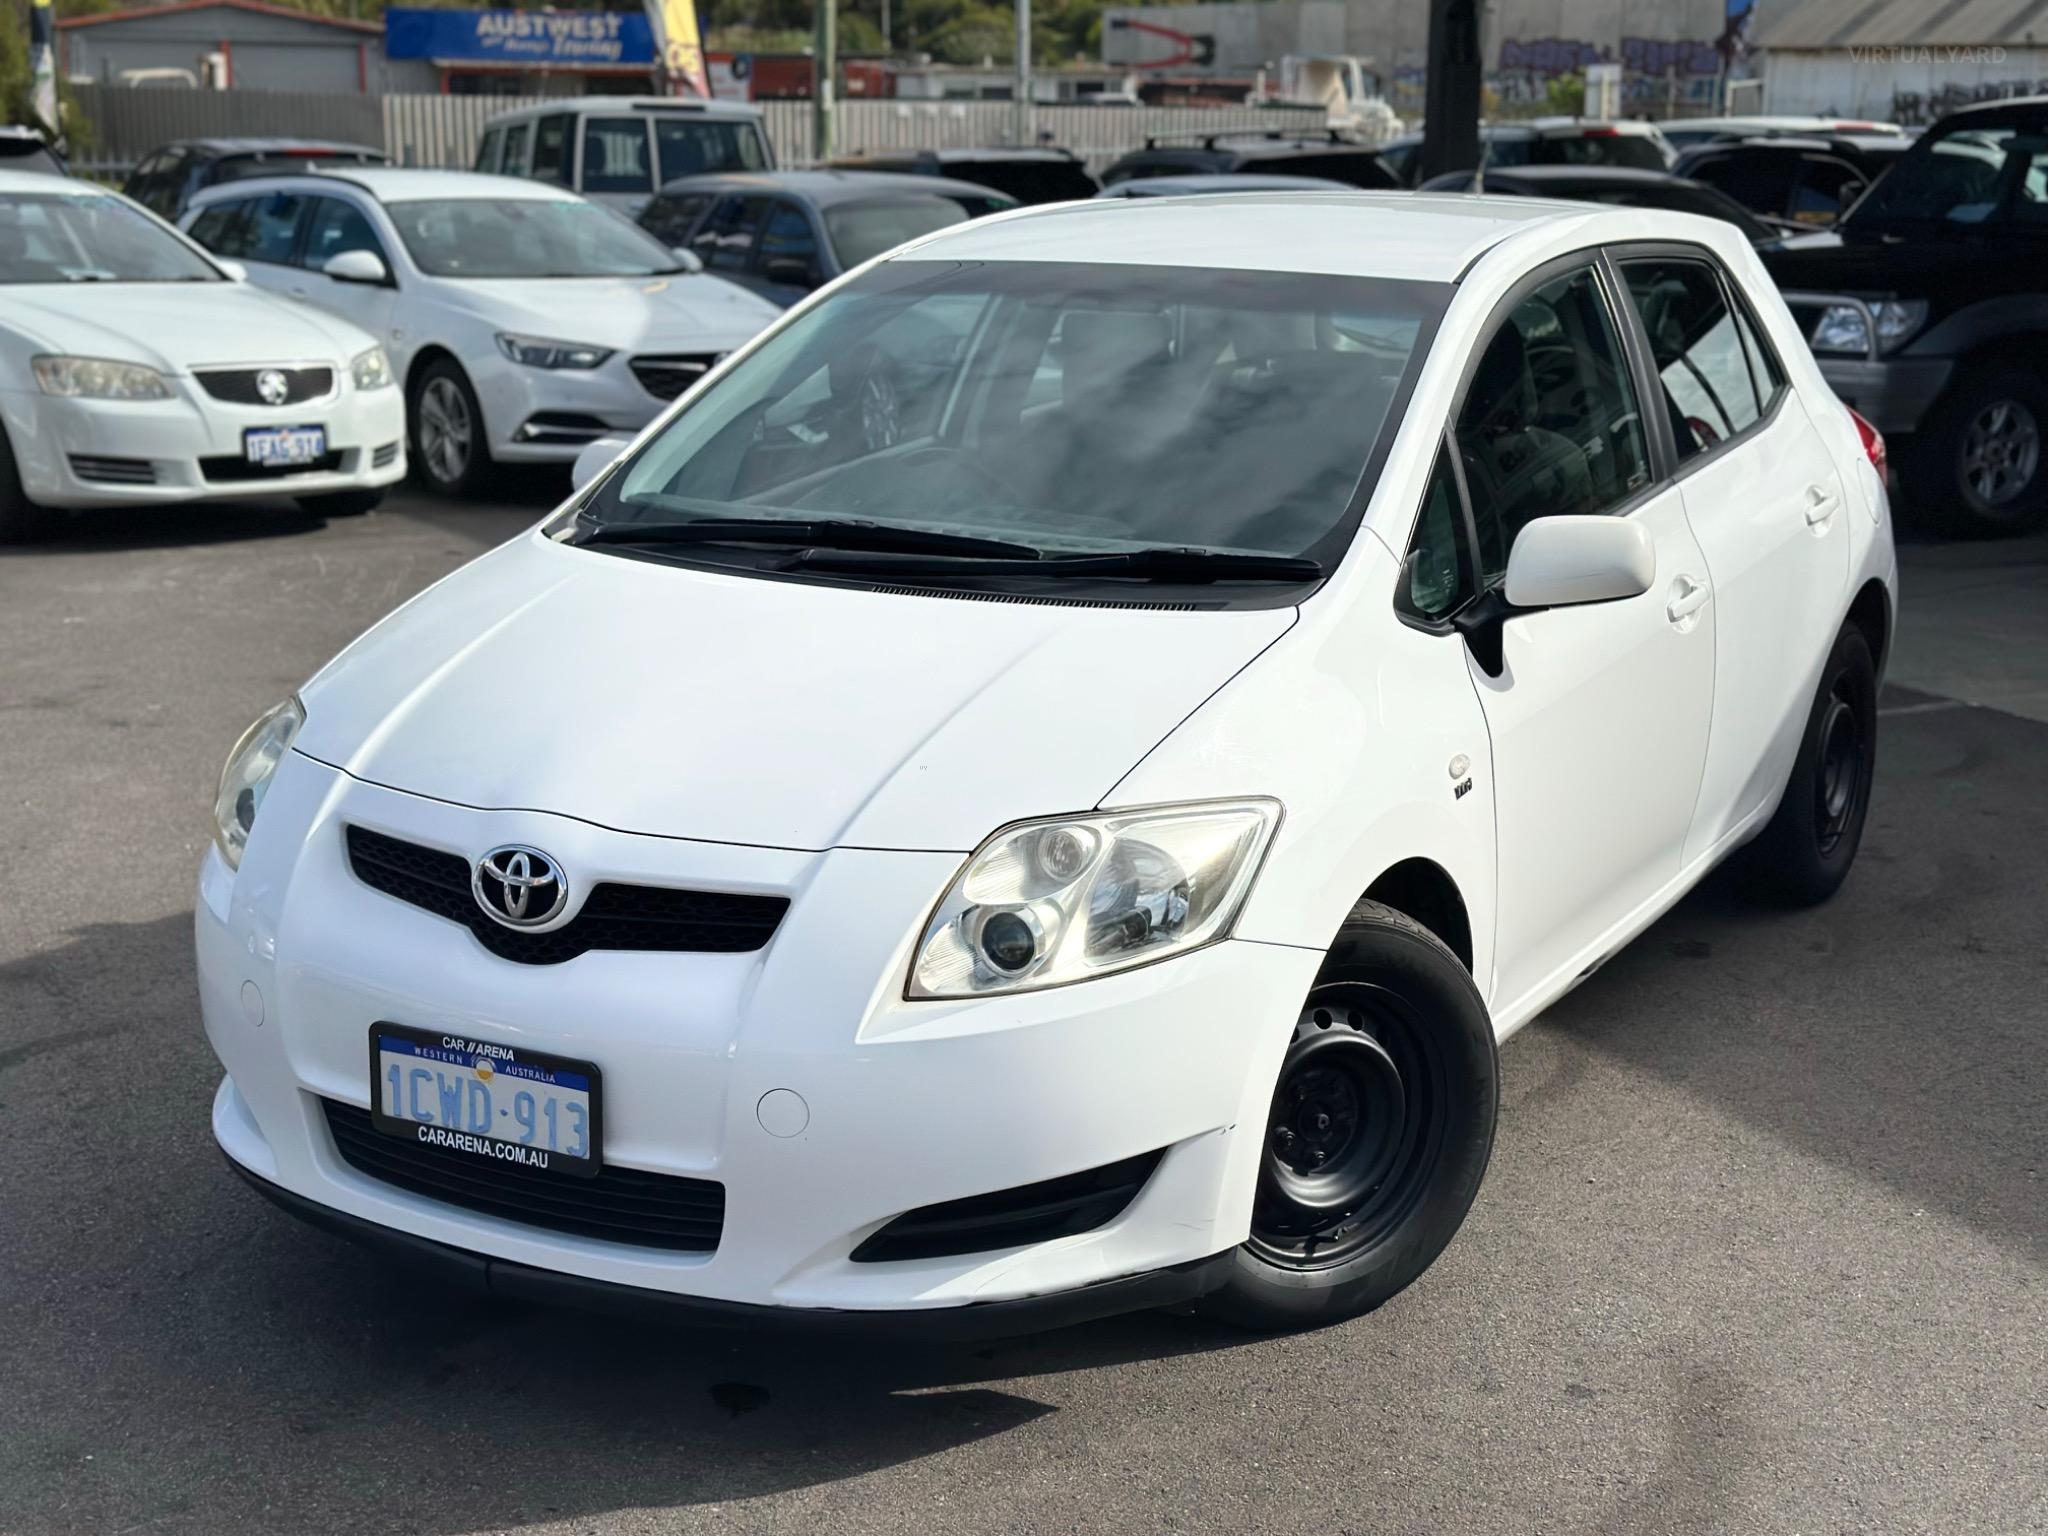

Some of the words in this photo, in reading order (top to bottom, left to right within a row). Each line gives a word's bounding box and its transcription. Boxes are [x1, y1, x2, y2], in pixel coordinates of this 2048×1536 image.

[477, 13, 622, 37] AUSTWEST
[414, 1047, 463, 1065] WESTERN
[505, 1065, 556, 1084] AUSTRALIA
[418, 1125, 549, 1169] CARARENA.COM.AU
